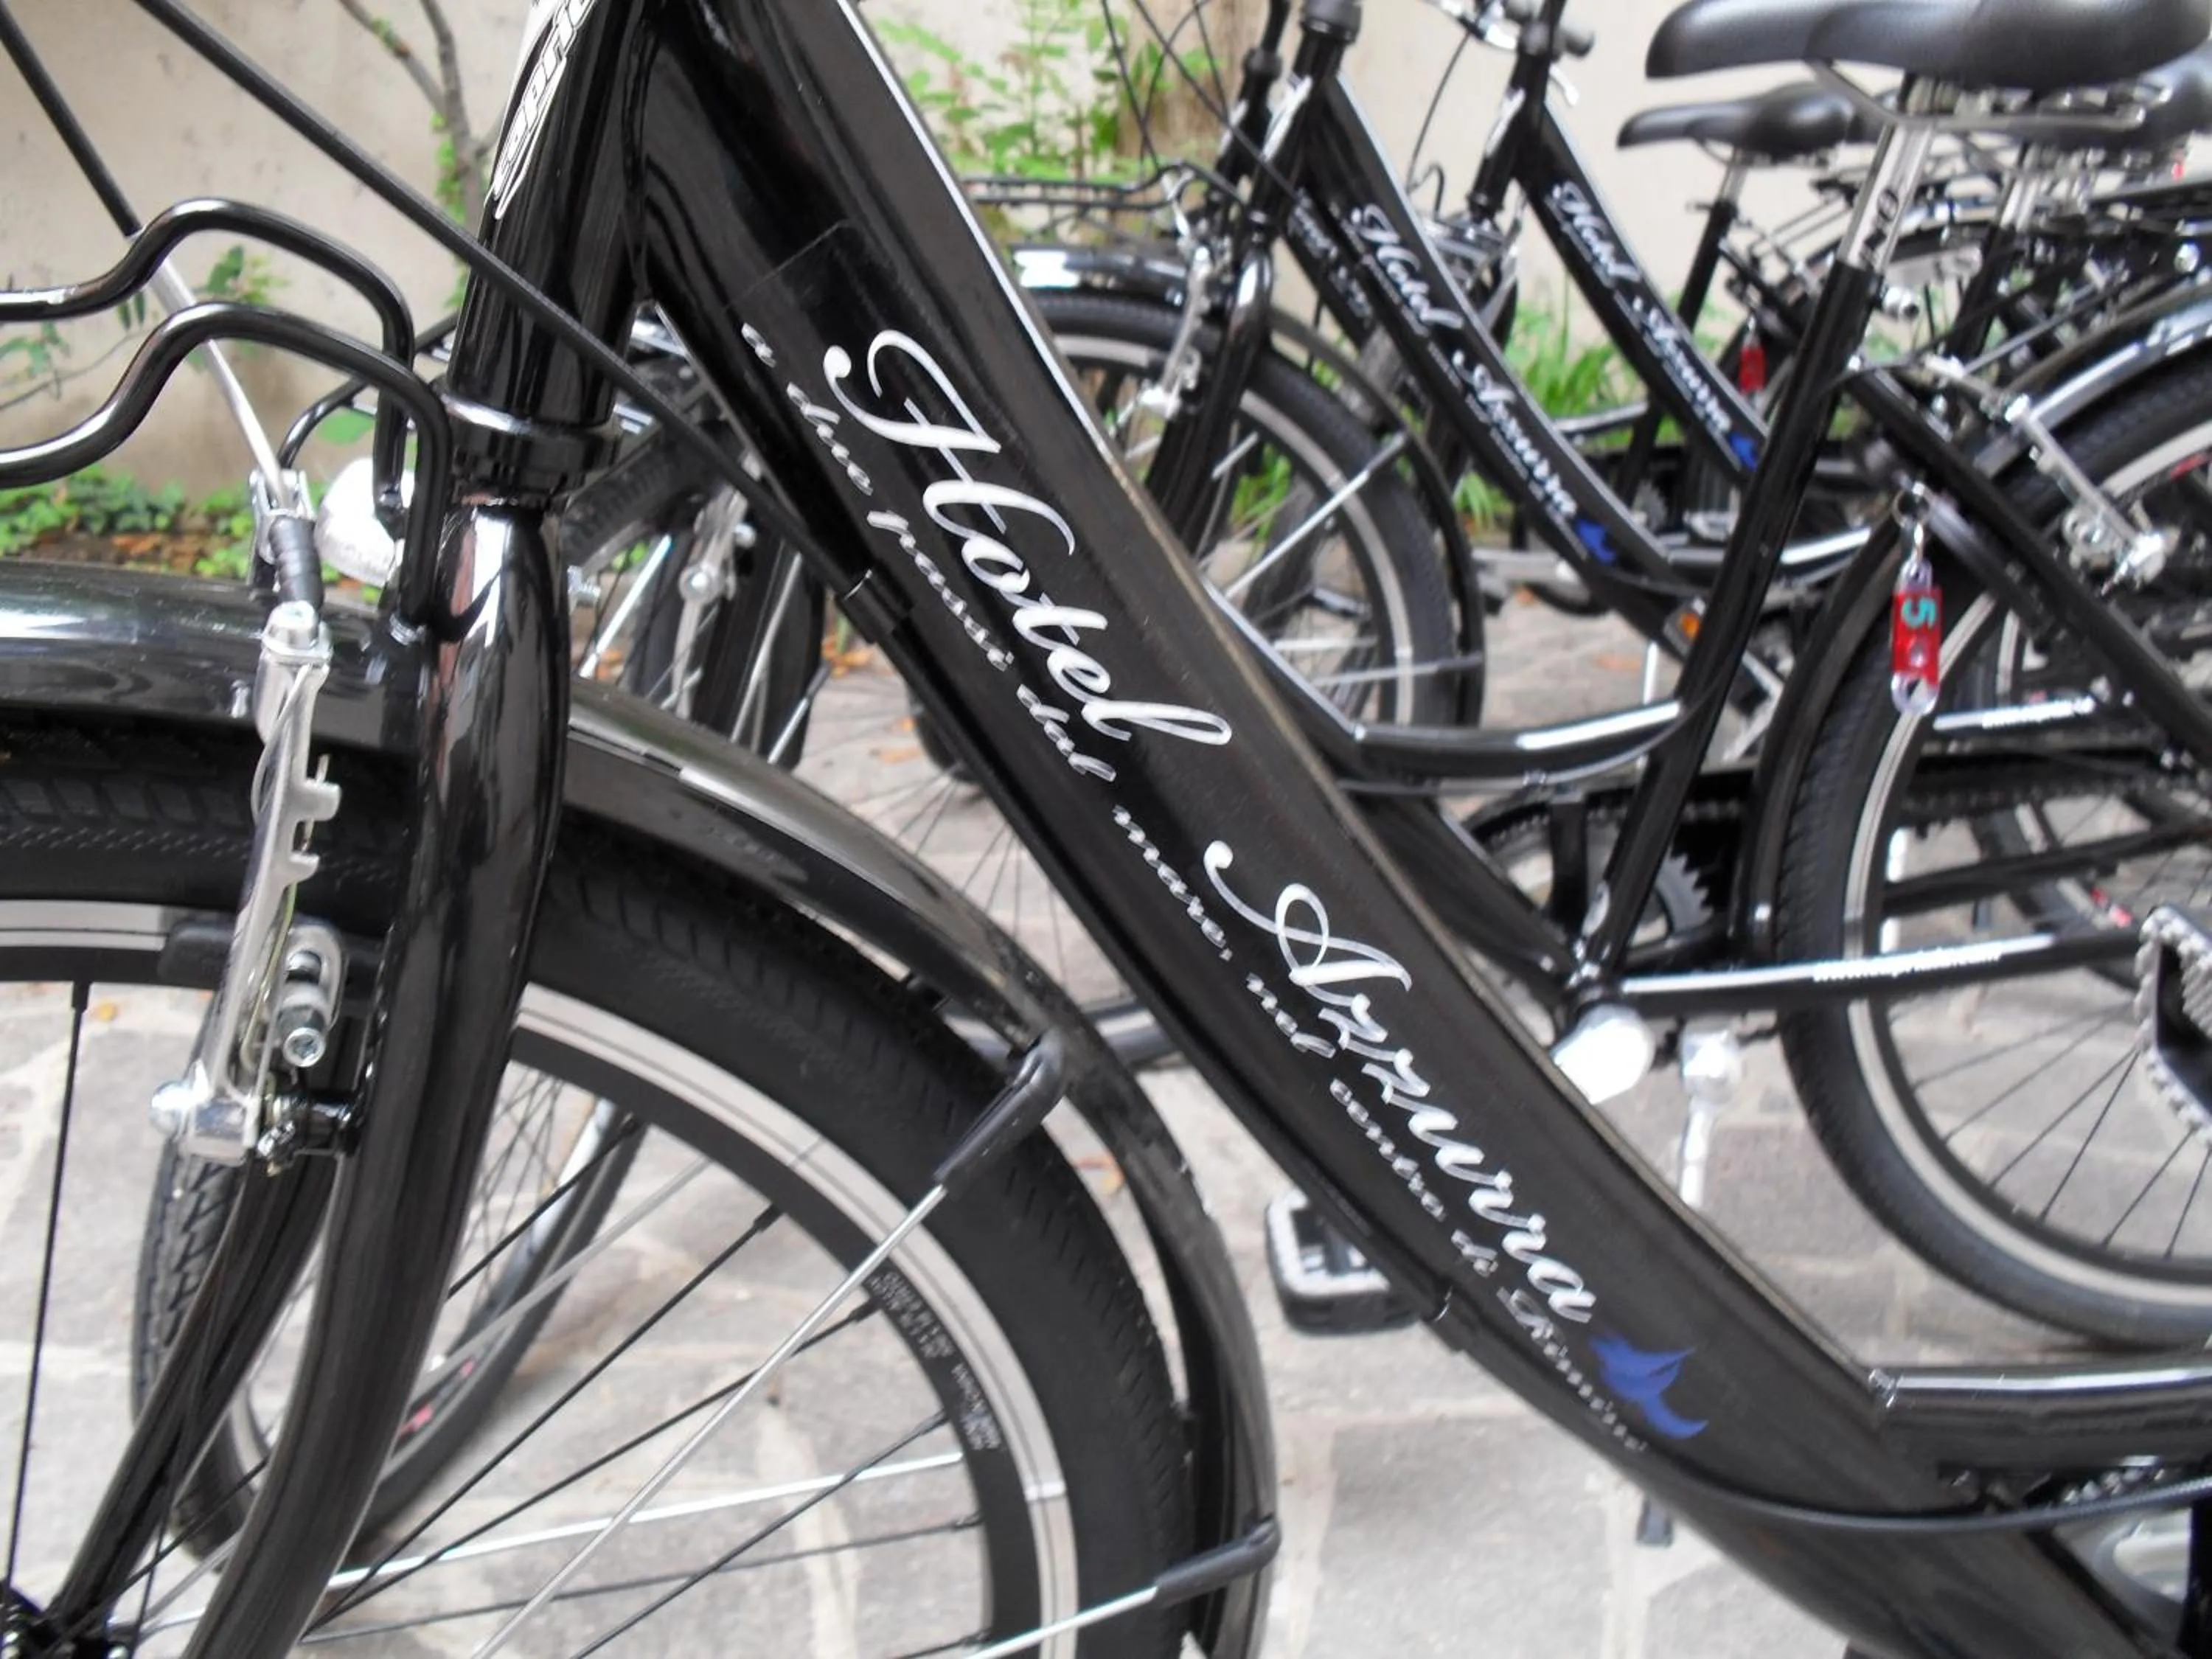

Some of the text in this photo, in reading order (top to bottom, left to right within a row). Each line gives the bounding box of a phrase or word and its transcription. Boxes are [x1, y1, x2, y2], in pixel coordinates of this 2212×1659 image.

[741, 322, 776, 368] a
[786, 381, 874, 496] due
[866, 510, 1015, 671] passi
[1016, 684, 1117, 783] dal
[1245, 971, 1337, 1059] nel
[1329, 1078, 1448, 1221] centro
[823, 329, 1232, 745] Hotel
[1203, 841, 1598, 1324] Azzurra
[1902, 597, 1938, 630] 5
